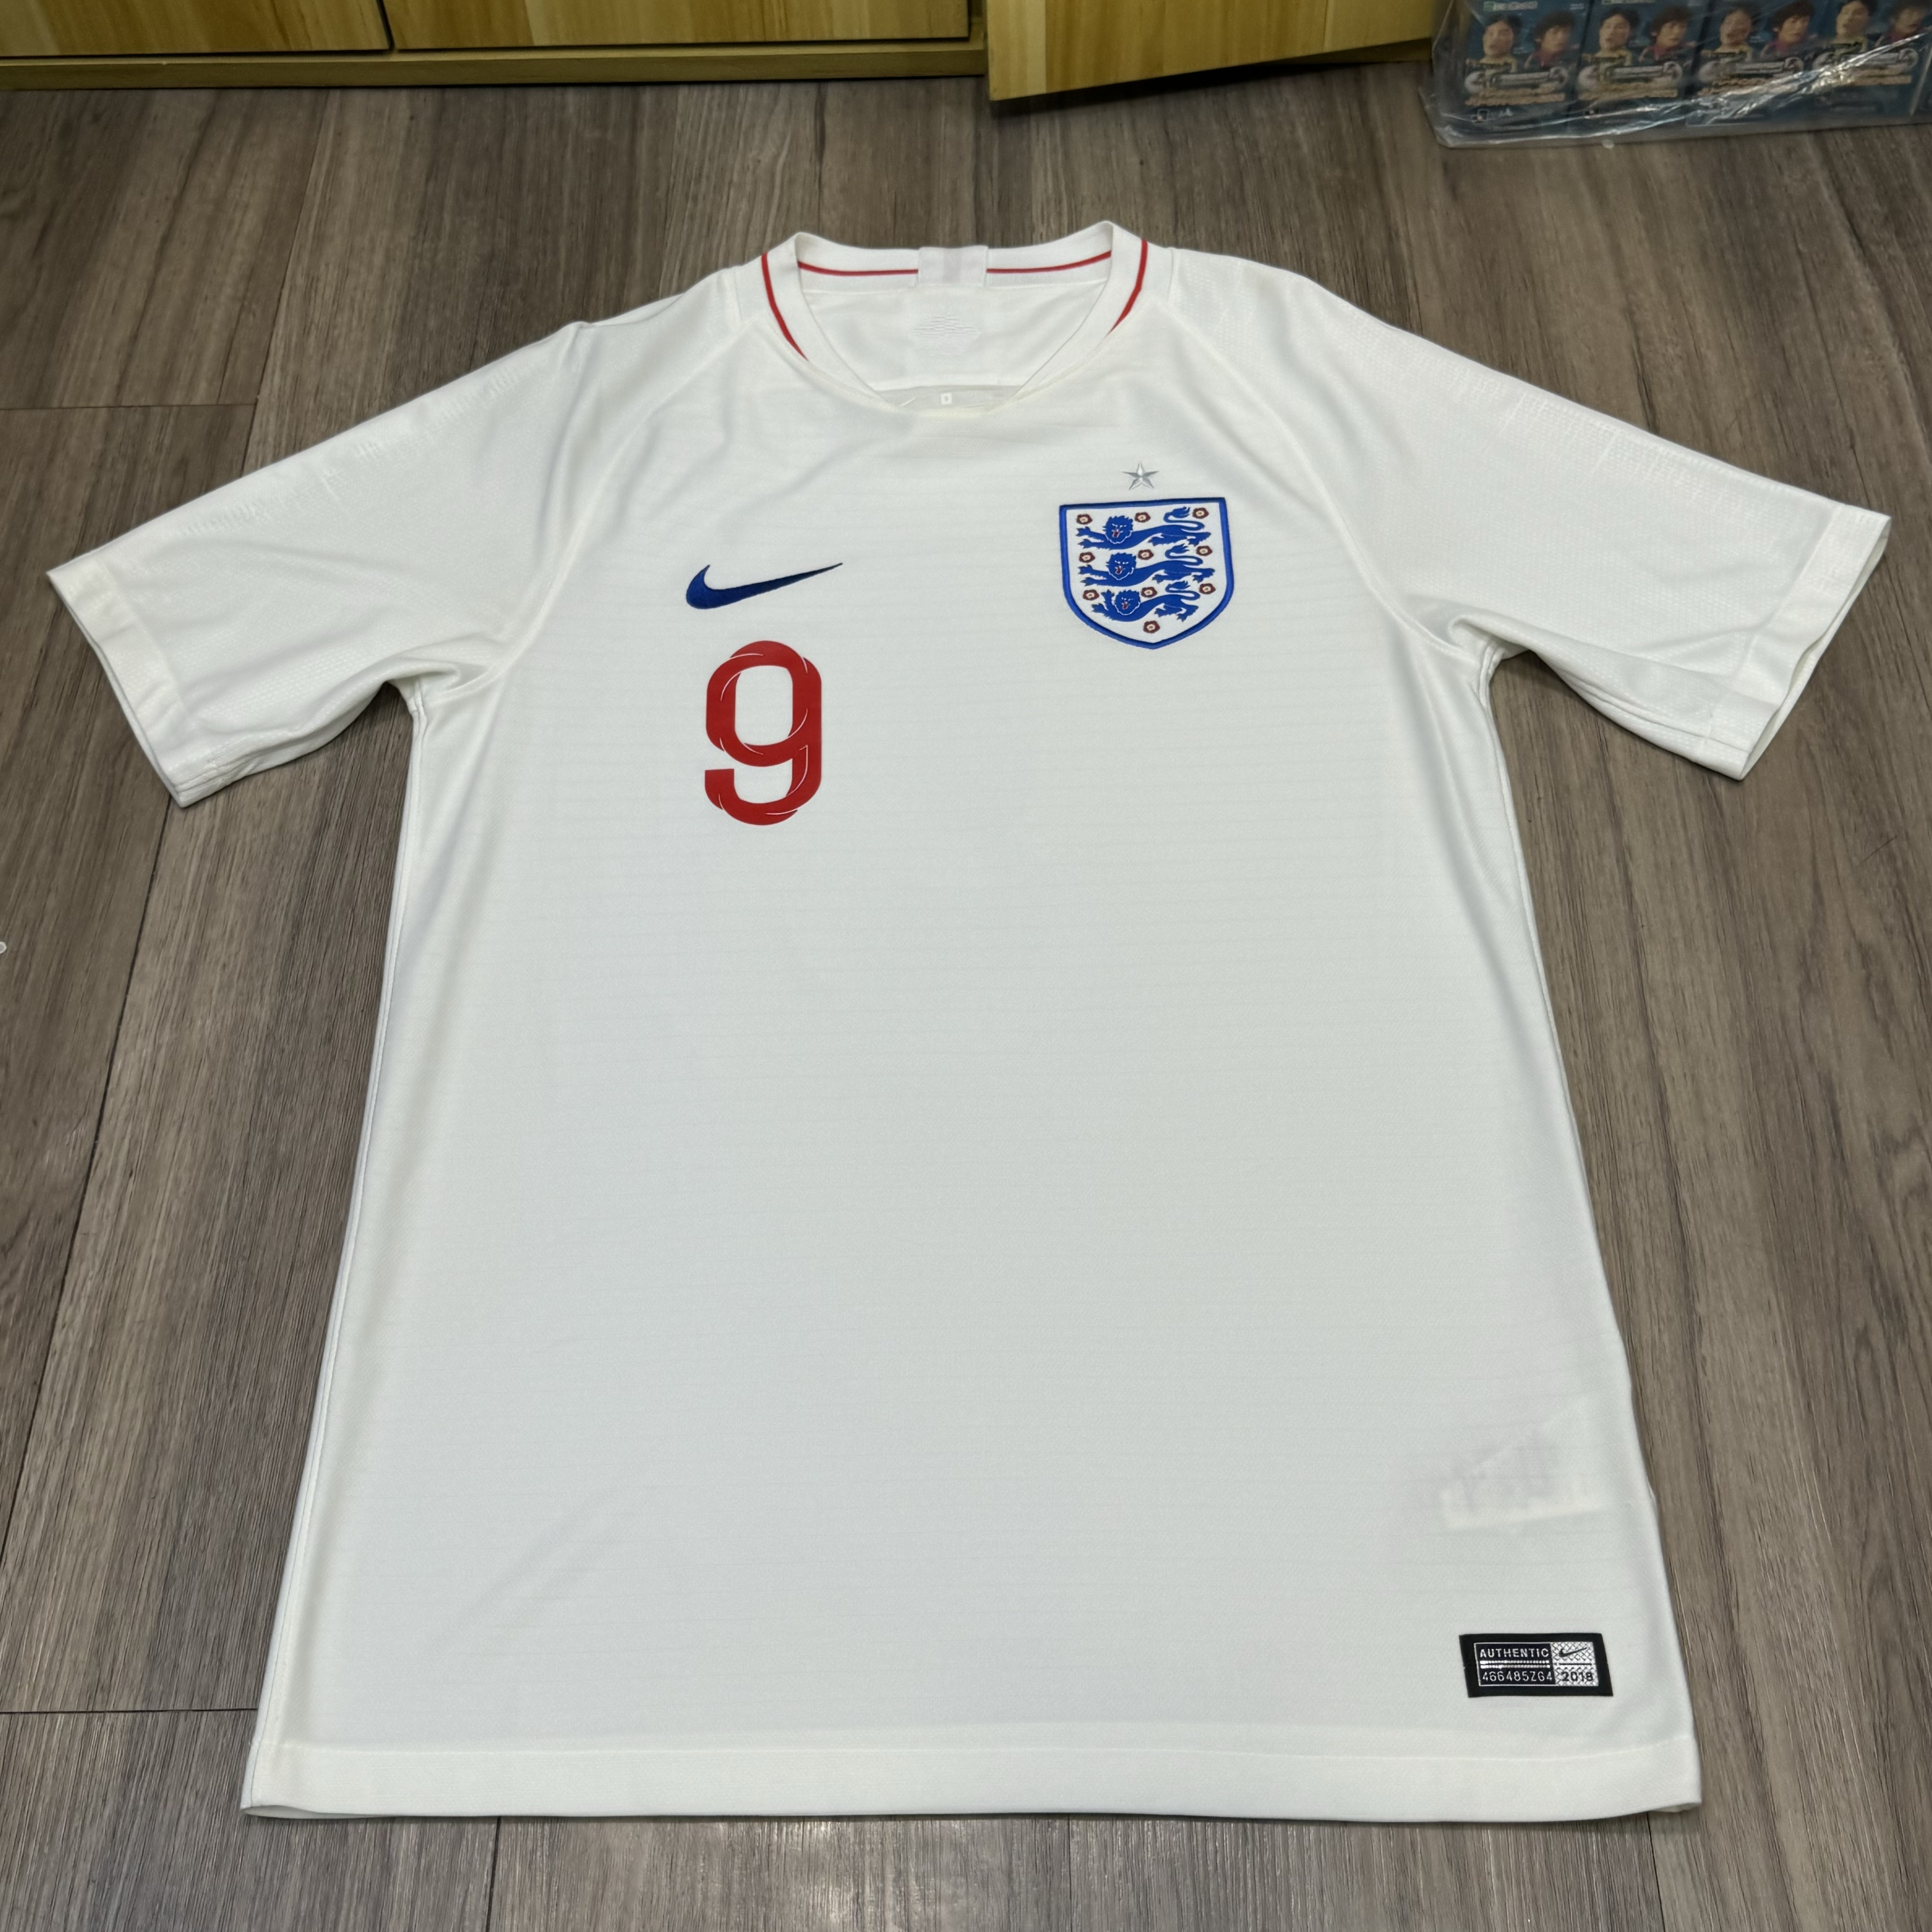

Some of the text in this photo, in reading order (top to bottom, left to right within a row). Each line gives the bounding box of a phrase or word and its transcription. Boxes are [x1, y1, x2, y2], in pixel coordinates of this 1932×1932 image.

[705, 640, 822, 825] 9
[1480, 1648, 1549, 1658] AUTHENTIC
[1561, 1671, 1593, 1682] 2018
